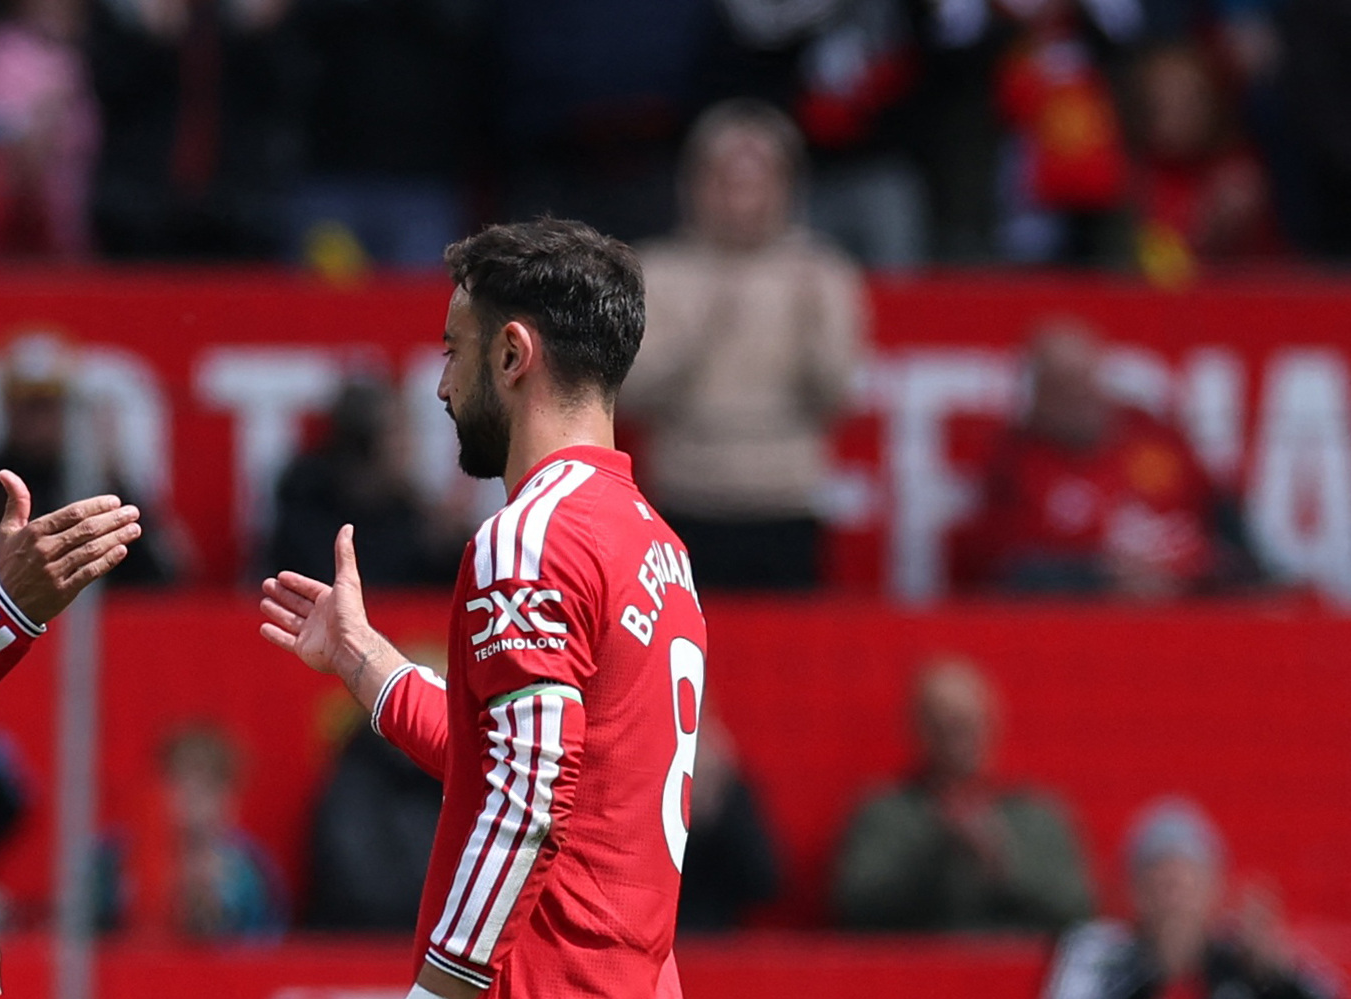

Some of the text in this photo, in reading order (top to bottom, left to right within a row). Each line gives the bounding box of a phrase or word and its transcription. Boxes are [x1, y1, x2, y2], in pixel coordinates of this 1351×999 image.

[466, 587, 568, 646] DXC
[474, 637, 567, 662] TECHNOLOGY
[661, 636, 705, 875] 8
